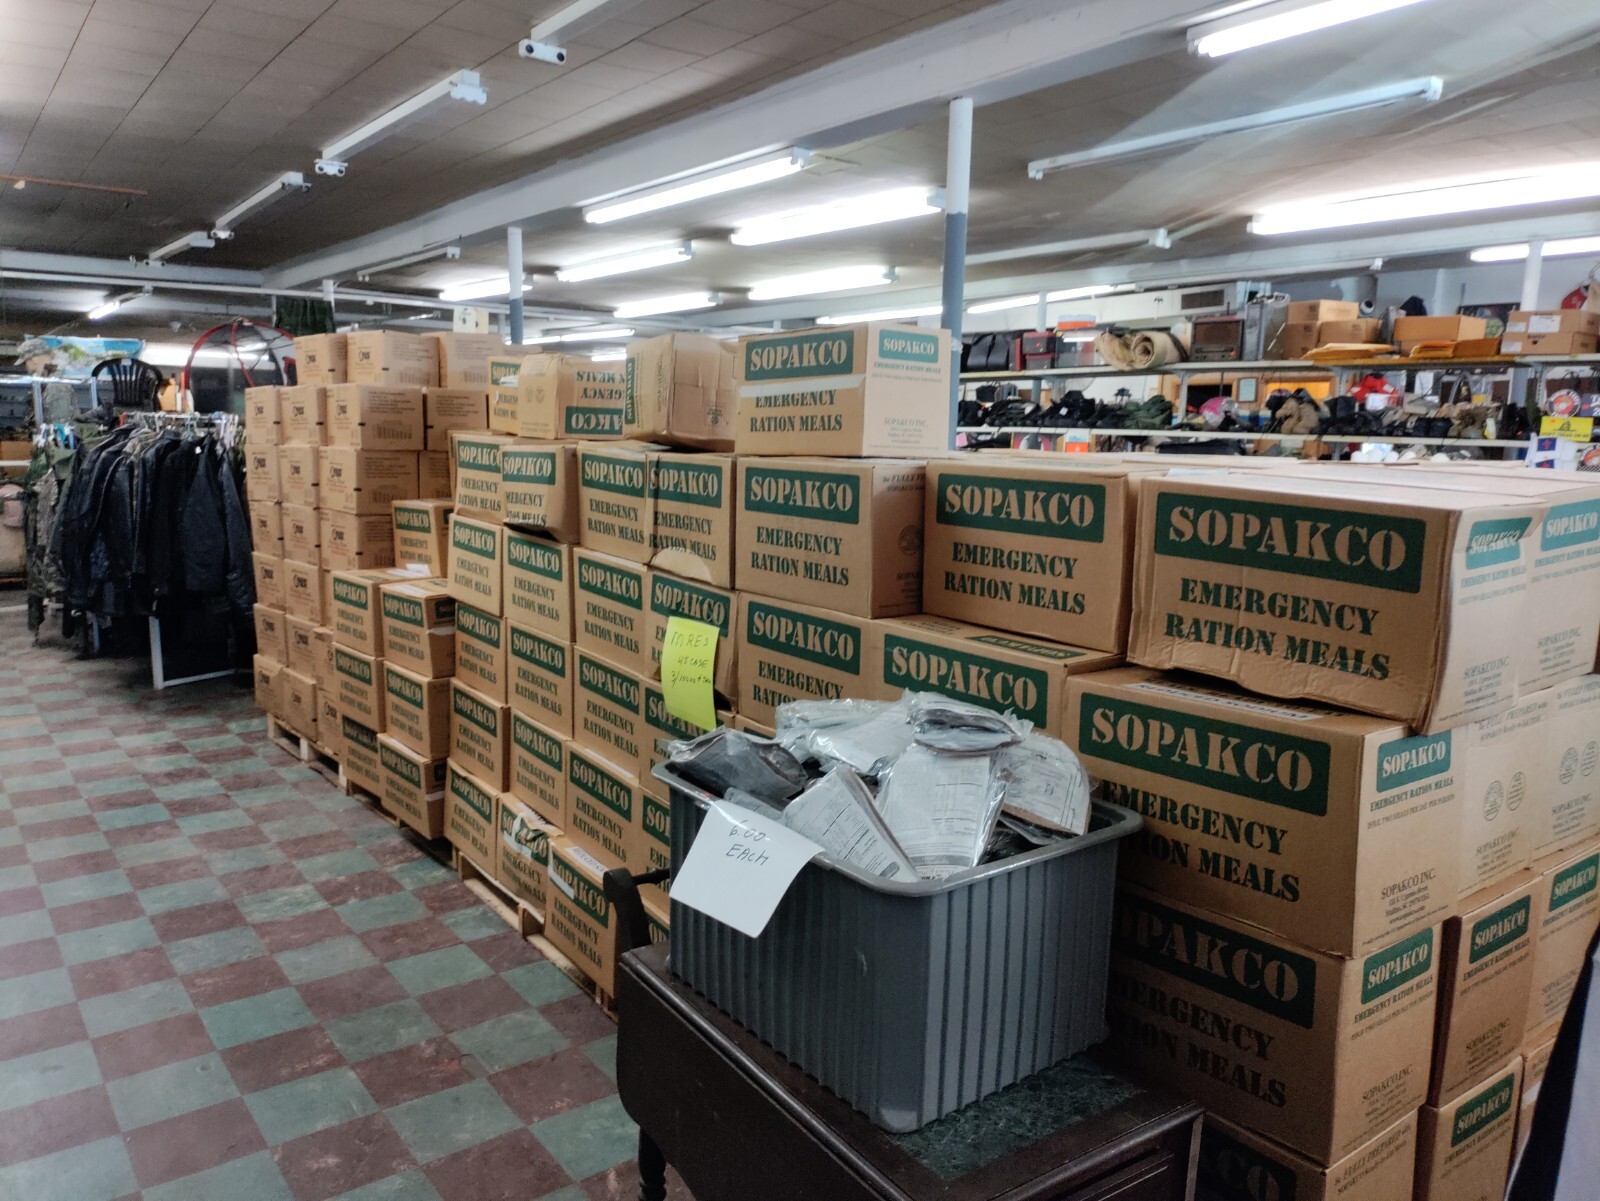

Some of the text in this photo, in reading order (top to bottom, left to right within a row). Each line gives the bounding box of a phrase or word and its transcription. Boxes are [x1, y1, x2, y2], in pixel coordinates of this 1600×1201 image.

[750, 339, 848, 371] SOPAKCO
[883, 338, 935, 355] SOPAKCO
[576, 370, 615, 383] MEALS
[755, 389, 837, 408] EMERGENCY
[571, 412, 623, 431] AKCO
[750, 414, 842, 432] RATION MEALS
[504, 457, 551, 477] SOPAKCO
[584, 460, 643, 489] SOPAKCO
[650, 467, 718, 497] SOPAKCO
[480, 498, 501, 511] MEALS
[590, 499, 638, 521] EMERGENCY
[751, 476, 853, 511] SOPAKCO
[945, 484, 1095, 528] SOPAKCO
[455, 525, 494, 552] SOPAKCO
[588, 518, 644, 544] RATION MEALS
[654, 511, 712, 535] EMERGENCY
[1169, 505, 1406, 571] SOPAKCO
[1546, 512, 1597, 537] SOPAKCO
[510, 542, 559, 573] SOPAKCO
[690, 540, 716, 561] MEALS
[757, 526, 842, 556] EMERGENCY
[751, 552, 849, 586] RATION MEALS
[952, 542, 1078, 579] EMERGENCY
[514, 576, 555, 600] EMERGENCY
[581, 564, 639, 600] SOPAKCO
[944, 571, 1012, 602] RATION
[1018, 584, 1085, 615] MEALS
[385, 597, 421, 625] SOPAKCO
[512, 593, 559, 621] RATION MEALS
[587, 602, 635, 632] EMERGENCY
[654, 582, 725, 626] SOPAKCO
[1180, 577, 1379, 636] EMERGENCY
[459, 610, 498, 641] SOPAKCO
[584, 621, 611, 642] RATION
[614, 630, 639, 654] MEALS
[753, 611, 853, 661] SOPAKCO
[513, 633, 562, 669] SOPAKCO
[1165, 613, 1390, 681] RATION MEALS
[518, 667, 557, 696] EMERGENCY
[583, 663, 638, 706] SOPAKCO
[759, 660, 843, 699] EMERGENCY
[892, 645, 1037, 710] SOPAKCO
[456, 693, 495, 730] SOPAKCO
[515, 683, 562, 716] RATION MEALS
[587, 699, 635, 735] EMERGENCY
[515, 721, 559, 762] SOPAKCO
[584, 717, 611, 742] RATION
[614, 735, 639, 758] MEALS
[1091, 707, 1312, 792] SOPAKCO
[1382, 741, 1446, 777] SOPAKCO
[572, 760, 628, 811] SOPAKCO
[1370, 791, 1407, 811] EMERGENCY
[576, 797, 624, 839] EMERGENCY
[1102, 780, 1288, 855] EMERGENCY
[573, 813, 626, 862] RATION MEALS
[726, 844, 769, 866] EACH
[553, 857, 605, 917] SOPAKCO
[1198, 848, 1300, 903] MEALS
[1381, 876, 1419, 900] SOPAKCO
[1553, 866, 1595, 899] SOPAKCO
[554, 896, 598, 946] EMERGENCY
[1474, 909, 1524, 949] SOPAKCO
[552, 913, 602, 969] RATION MEALS
[1368, 944, 1428, 988] SOPAKCO
[1186, 1042, 1287, 1108] MEALS
[1457, 1088, 1509, 1134] SOPAKCO
